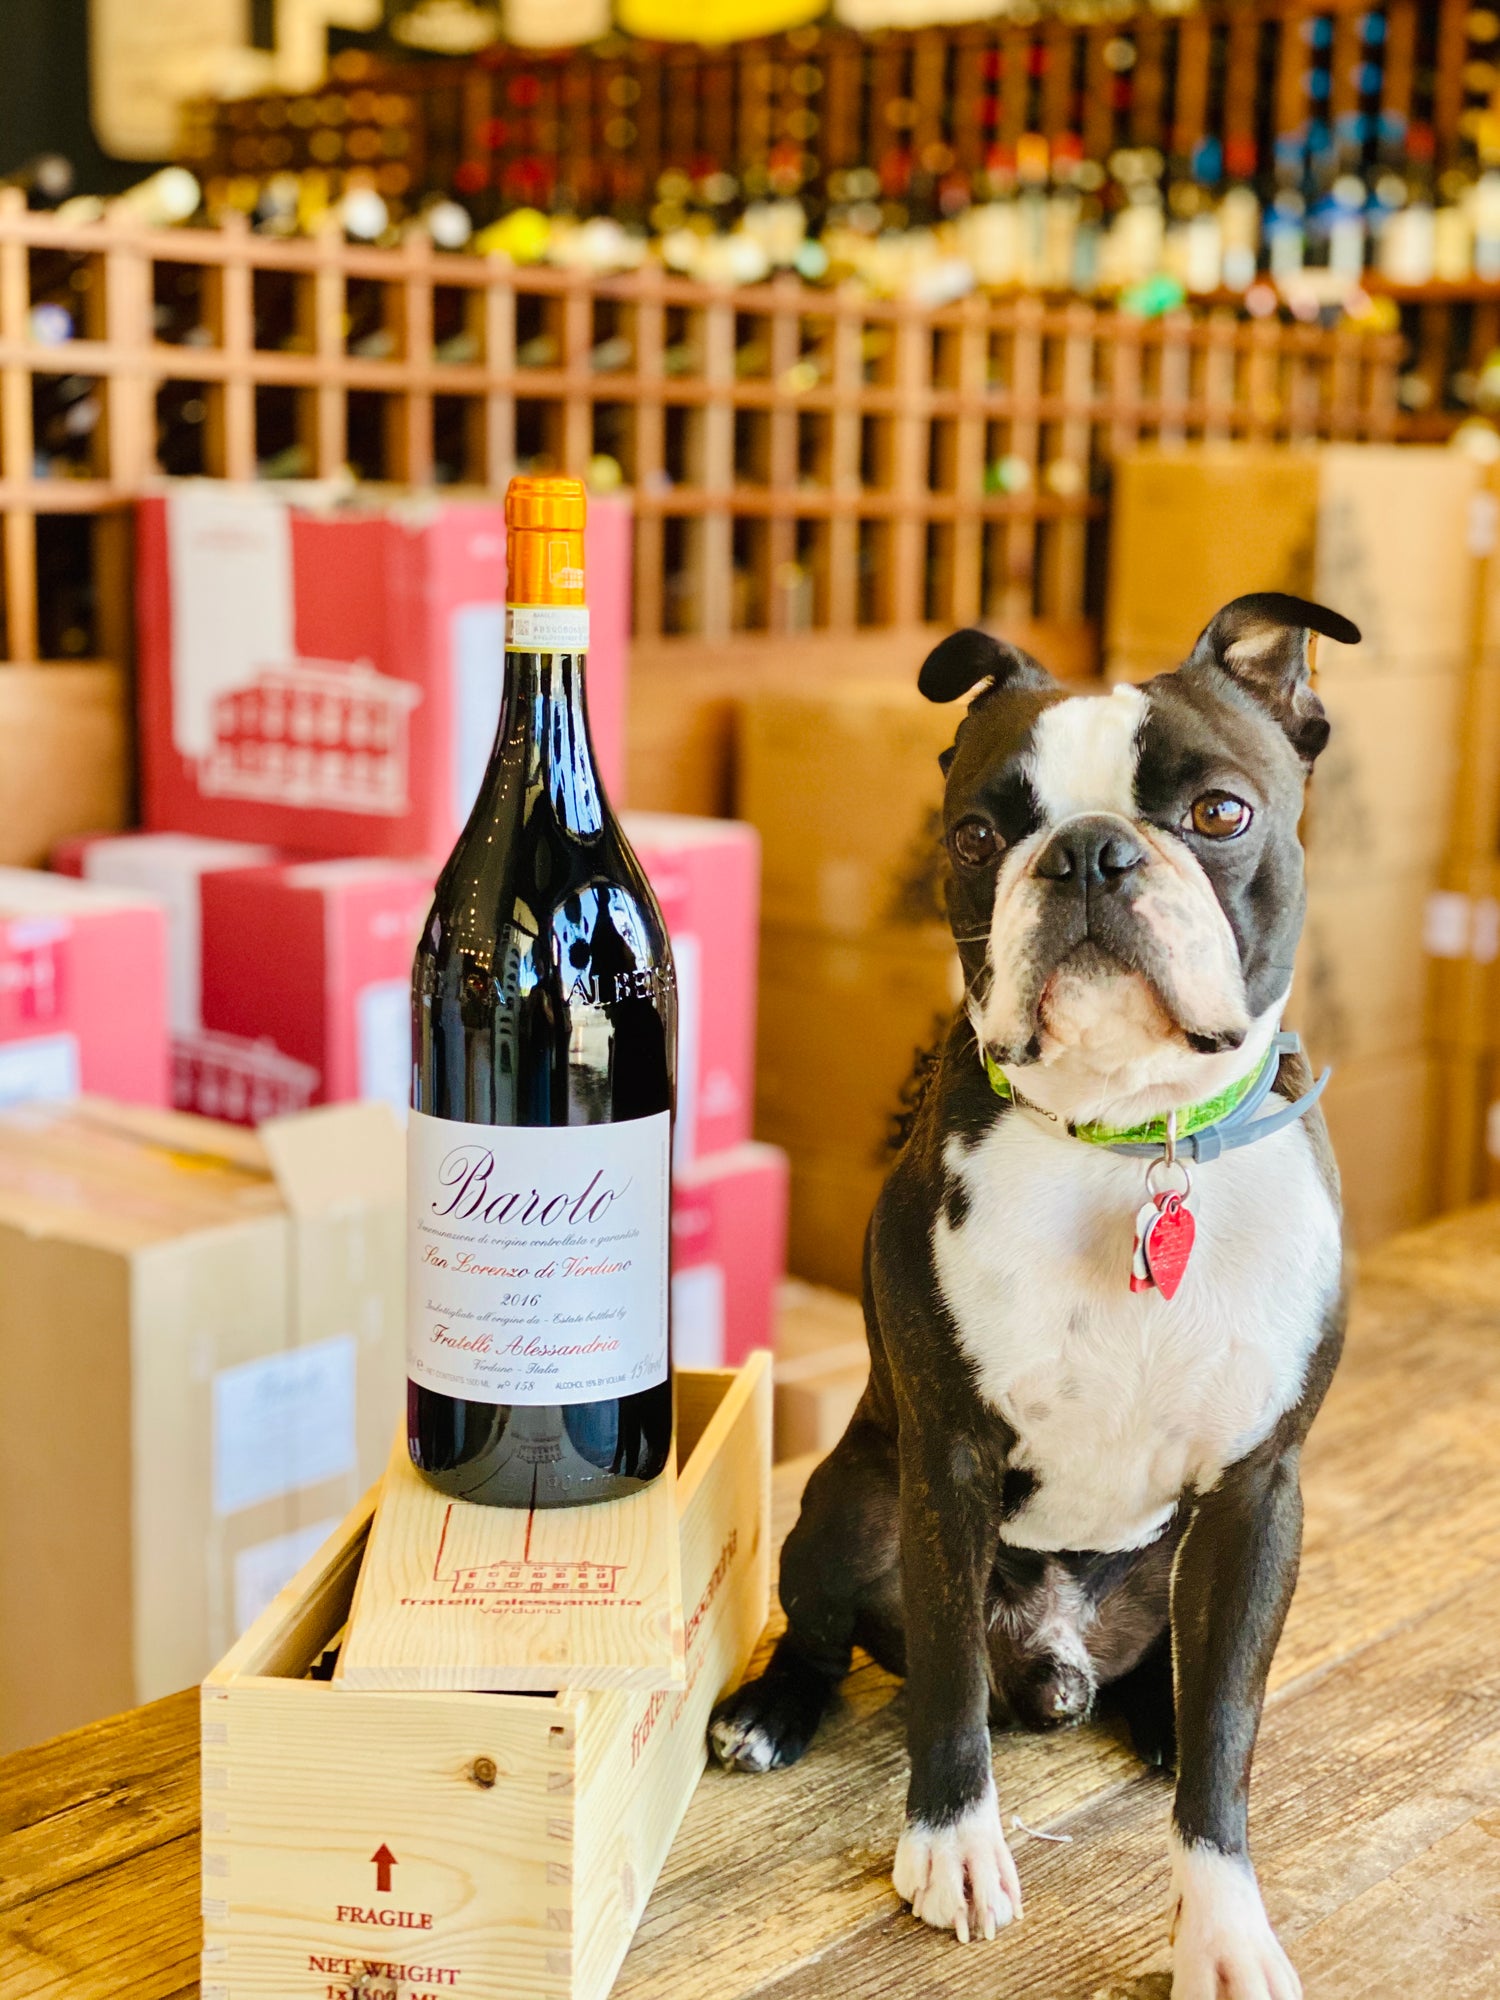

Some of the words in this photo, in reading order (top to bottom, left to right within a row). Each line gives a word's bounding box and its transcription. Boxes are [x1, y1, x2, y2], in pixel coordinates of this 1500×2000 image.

[432, 1145, 633, 1226] Barolo
[478, 1234, 488, 1244] di
[491, 1236, 527, 1249] origine
[530, 1233, 588, 1247] controllata
[596, 1228, 640, 1247] garantita
[421, 1245, 449, 1269] San
[451, 1252, 530, 1278] Lorenzo
[534, 1261, 559, 1278] di
[562, 1256, 632, 1278] Verduno
[500, 1293, 542, 1307] 2016
[553, 1312, 583, 1324] Estate
[585, 1308, 617, 1321] bottled
[616, 1305, 627, 1320] by
[430, 1324, 493, 1354] Fratelli
[496, 1334, 620, 1357] Alessandria
[473, 1359, 513, 1374] Verduno
[526, 1362, 560, 1375] Italia
[514, 1381, 536, 1391] 158
[400, 1598, 484, 1606] fratelli
[493, 1598, 642, 1606] alessandria
[336, 1904, 433, 1930] FRAGILE
[308, 1955, 356, 1975] NET
[361, 1960, 461, 1985] WEIGHT
